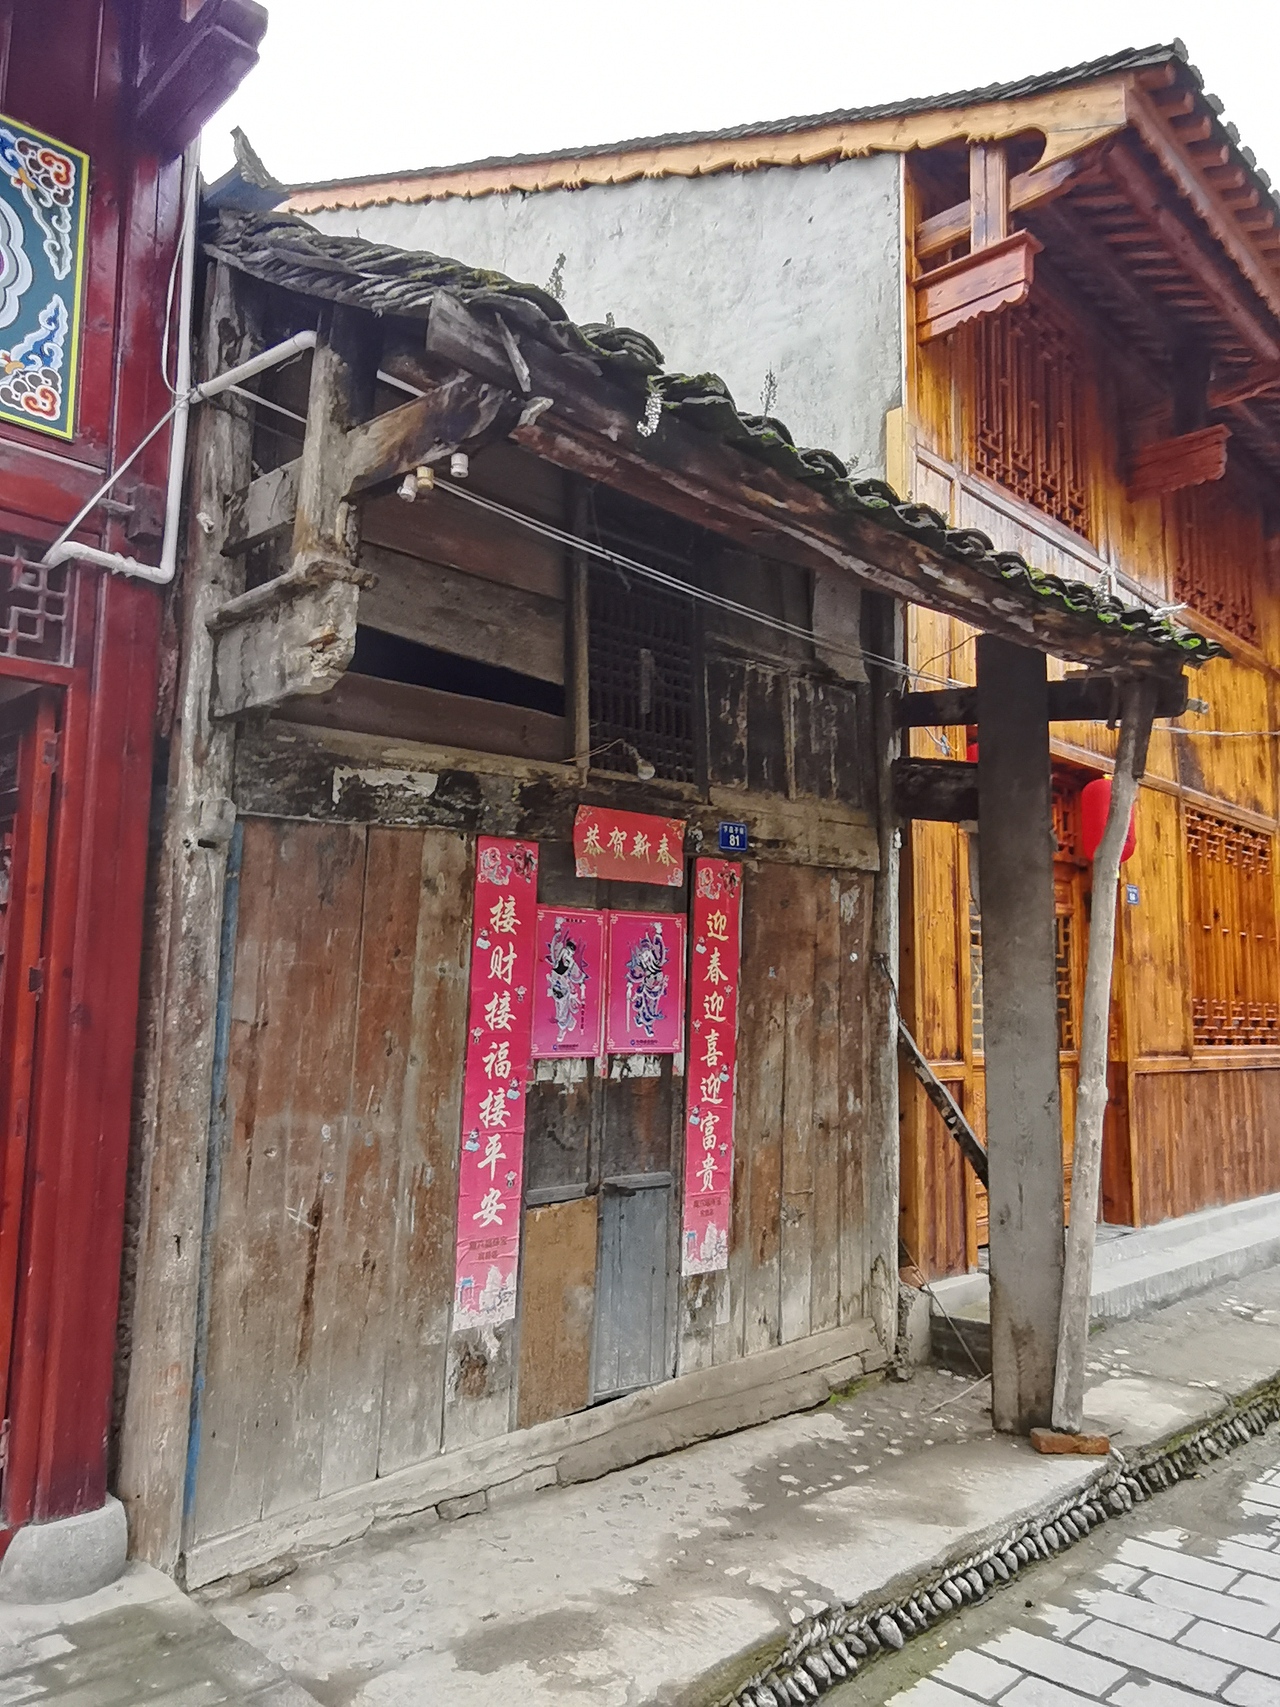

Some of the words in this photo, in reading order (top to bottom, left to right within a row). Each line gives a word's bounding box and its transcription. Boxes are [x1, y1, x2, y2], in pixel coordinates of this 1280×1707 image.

[583, 823, 679, 867] 恭贺新春
[729, 834, 740, 847] 81
[473, 895, 522, 1228] 接财接福接平安
[696, 909, 730, 1192] 迎春迎喜迎富贵
